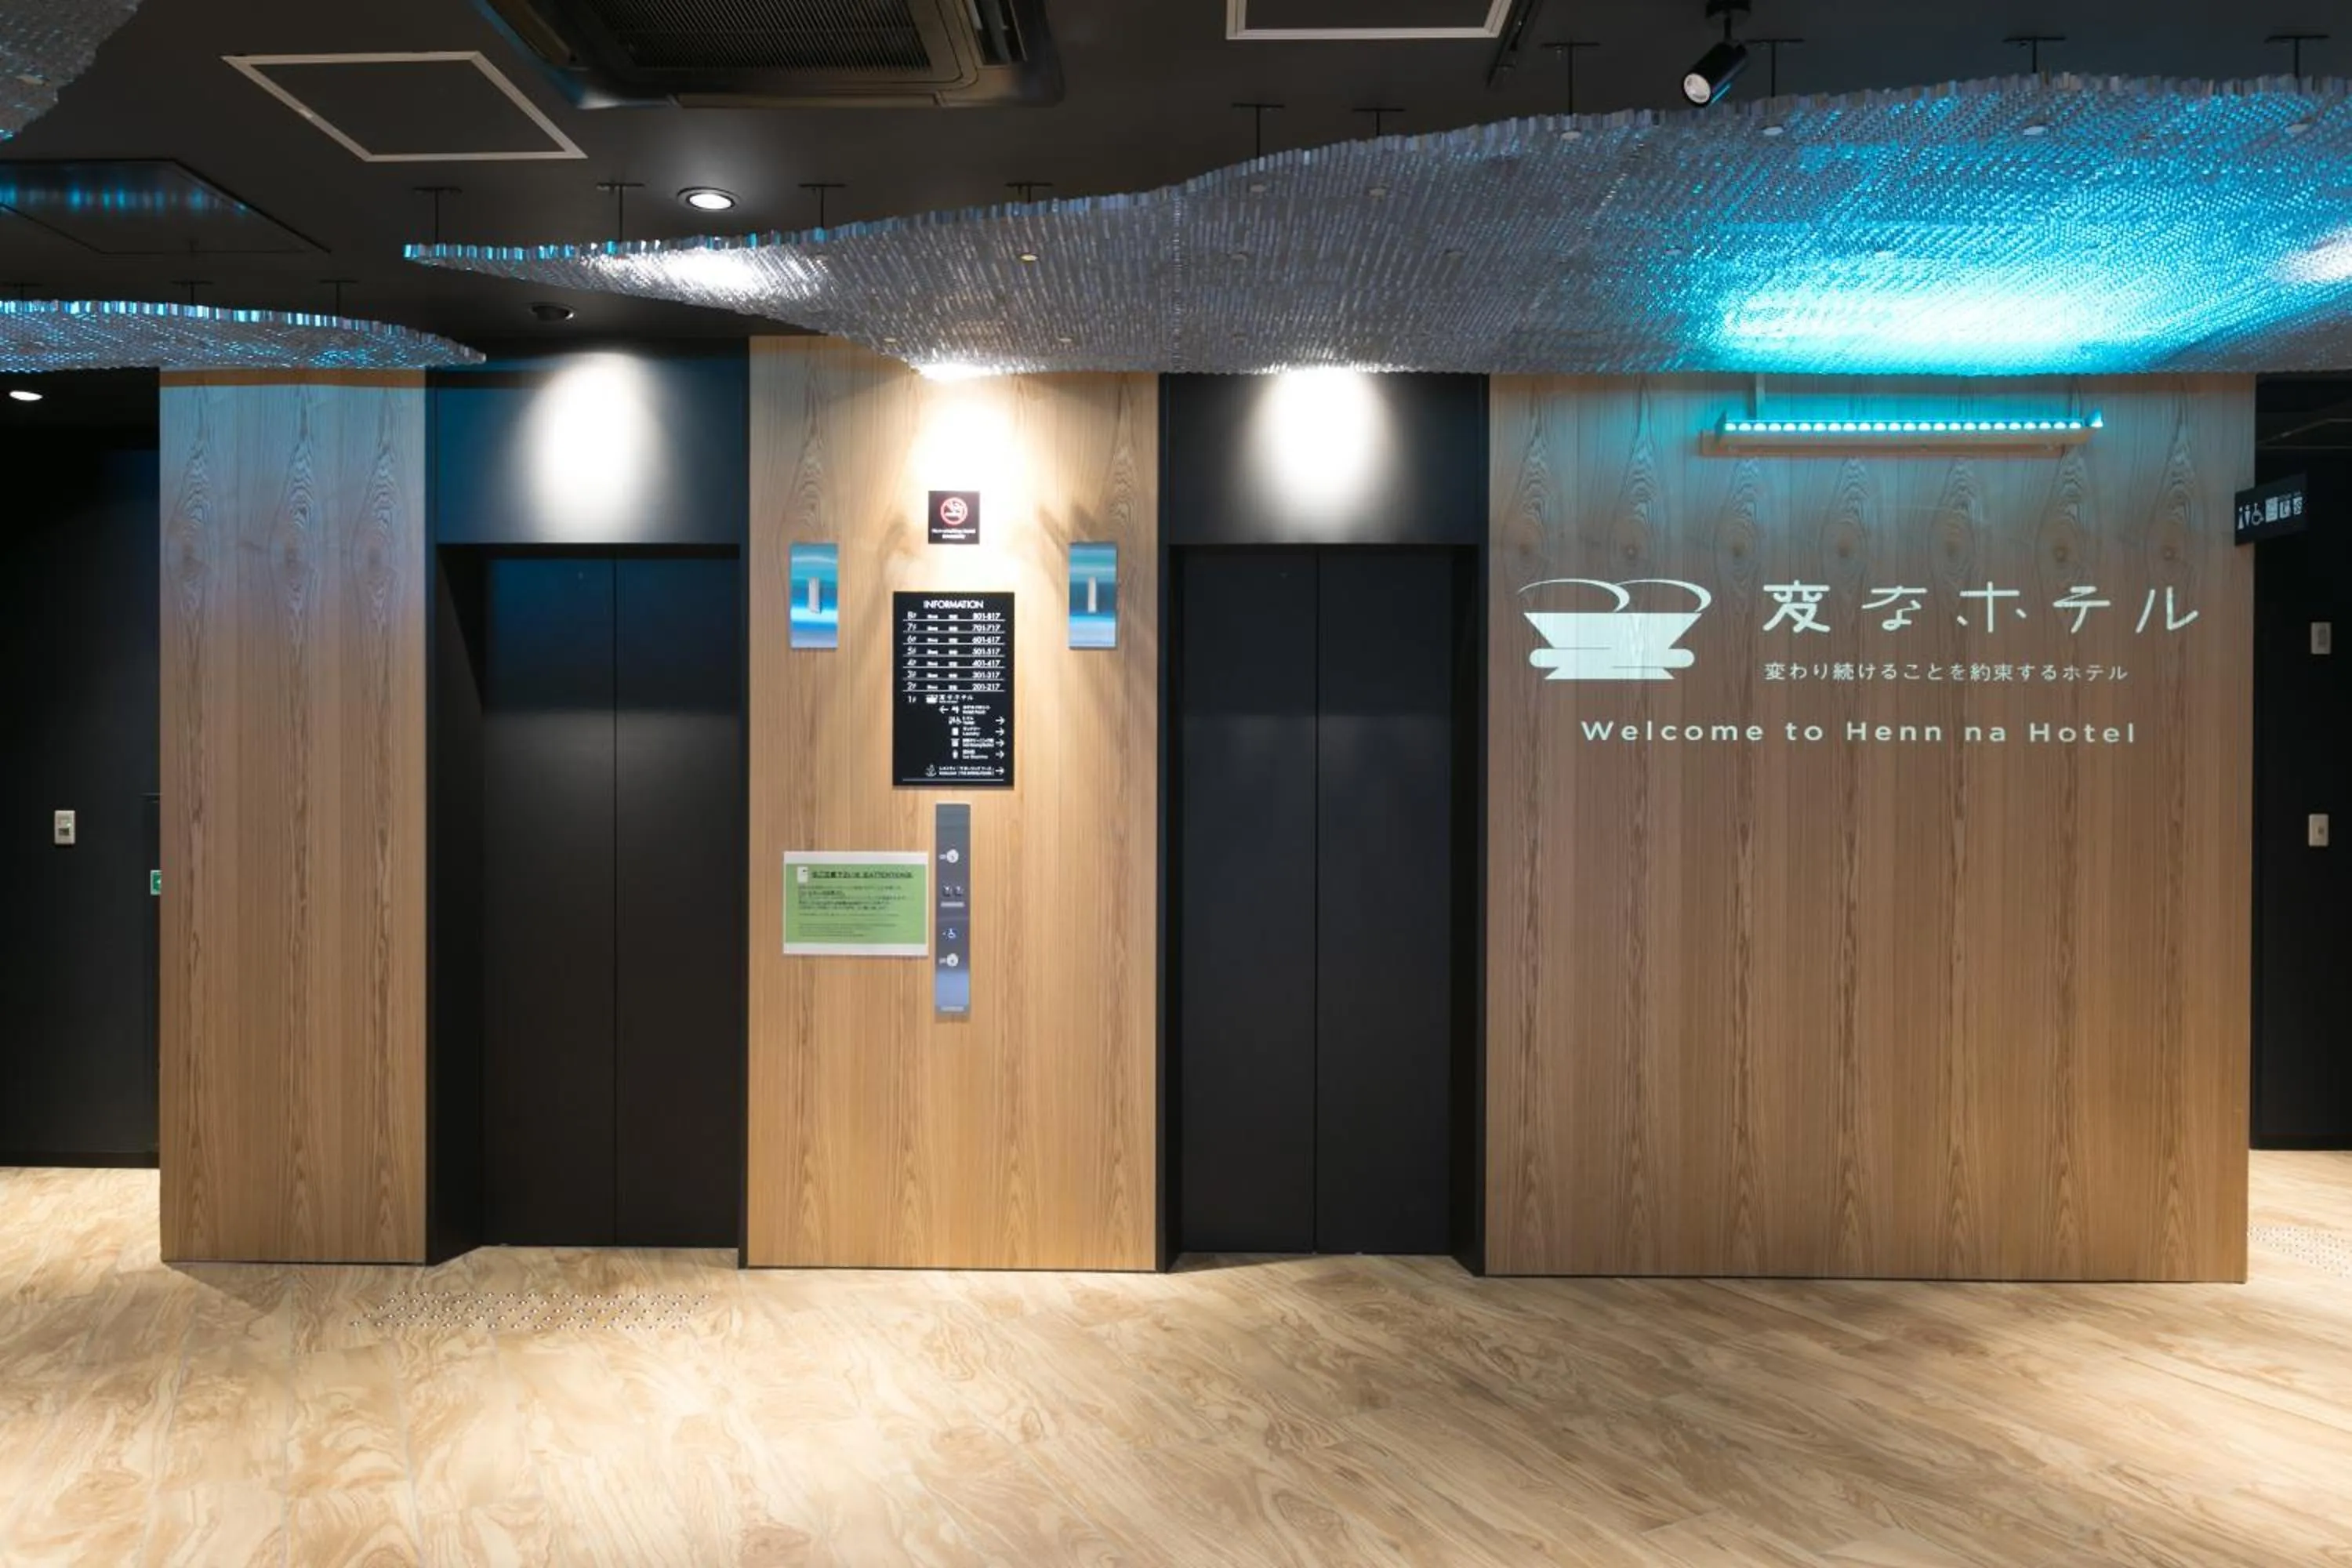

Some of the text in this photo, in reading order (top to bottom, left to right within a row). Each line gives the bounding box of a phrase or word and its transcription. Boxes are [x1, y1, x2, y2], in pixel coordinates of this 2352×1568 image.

[923, 600, 984, 609] INFORMATION
[1762, 579, 2199, 634] 変なホテル
[1764, 661, 2128, 682] 変わり続けることを約束するホテル
[1581, 720, 2134, 743] Welcome to Henn na Hotel
